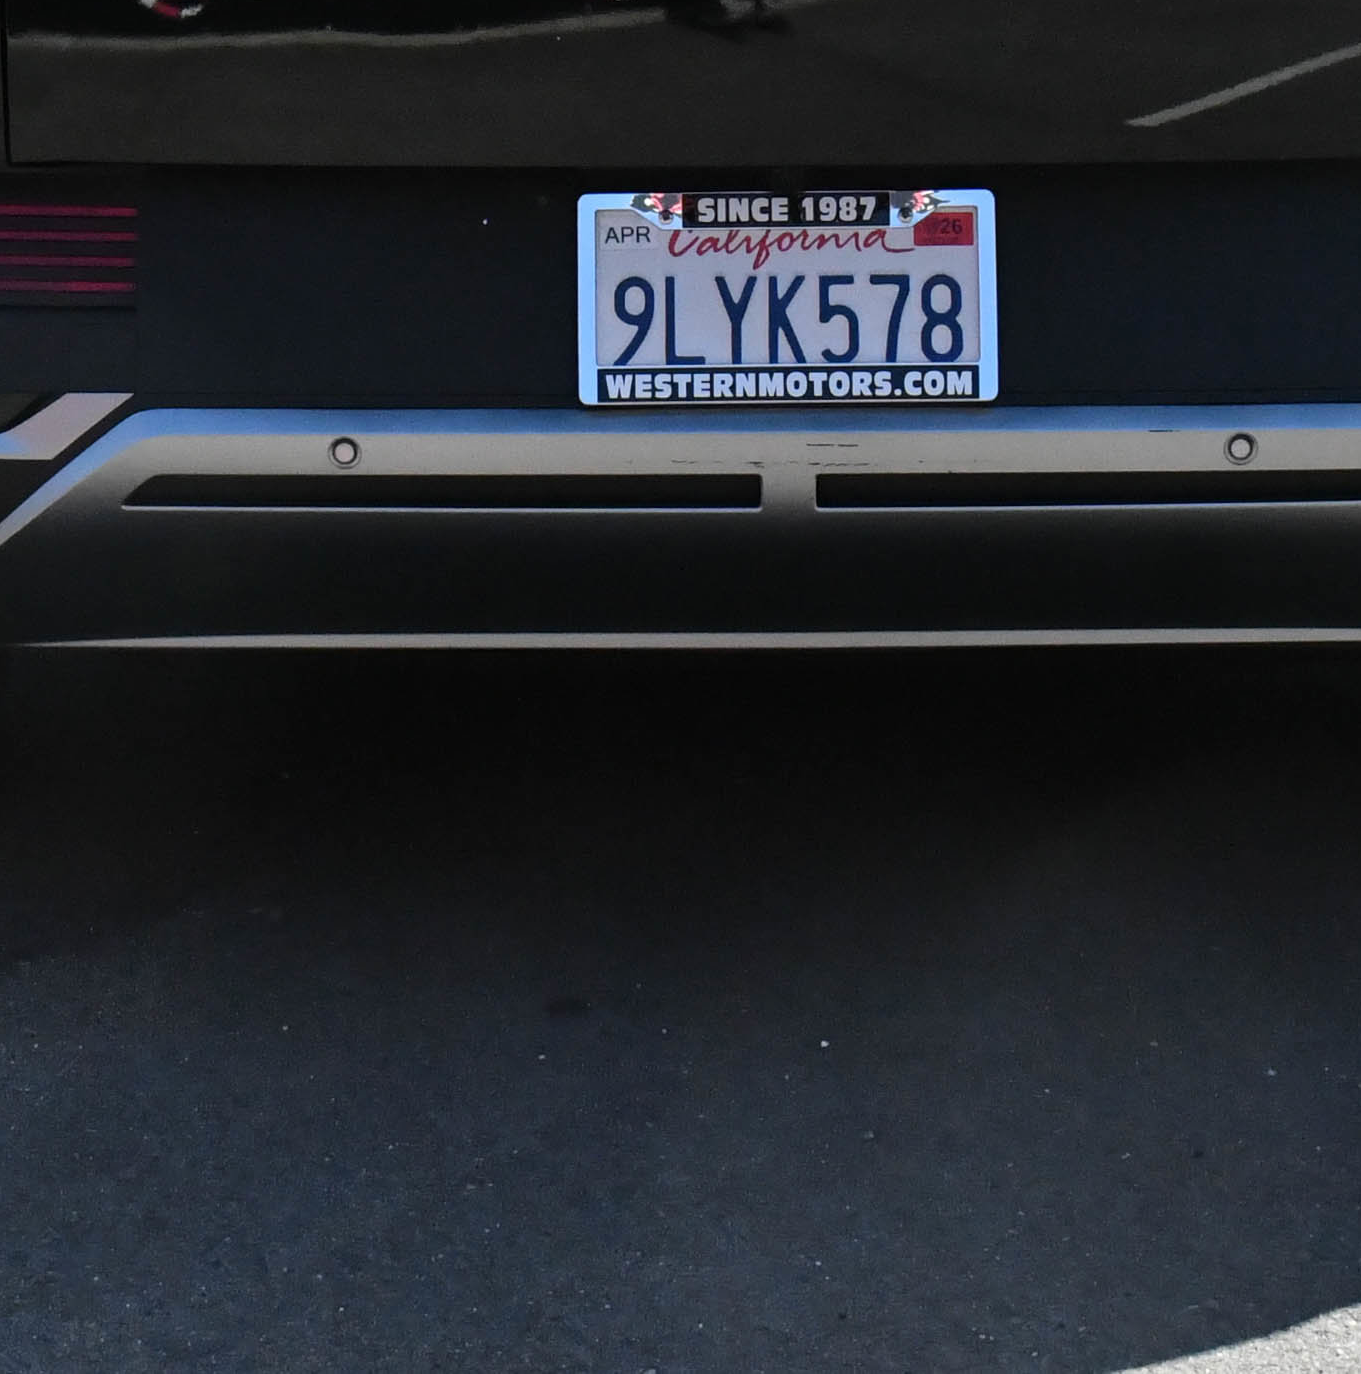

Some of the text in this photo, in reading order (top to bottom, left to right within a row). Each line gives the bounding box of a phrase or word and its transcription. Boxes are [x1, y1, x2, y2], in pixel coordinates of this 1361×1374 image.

[696, 195, 876, 223] SINCE 1987
[604, 226, 652, 245] APR
[668, 228, 916, 271] California
[612, 274, 963, 366] 9LYK578
[605, 371, 973, 400] WESTERNMOTORS.COM
